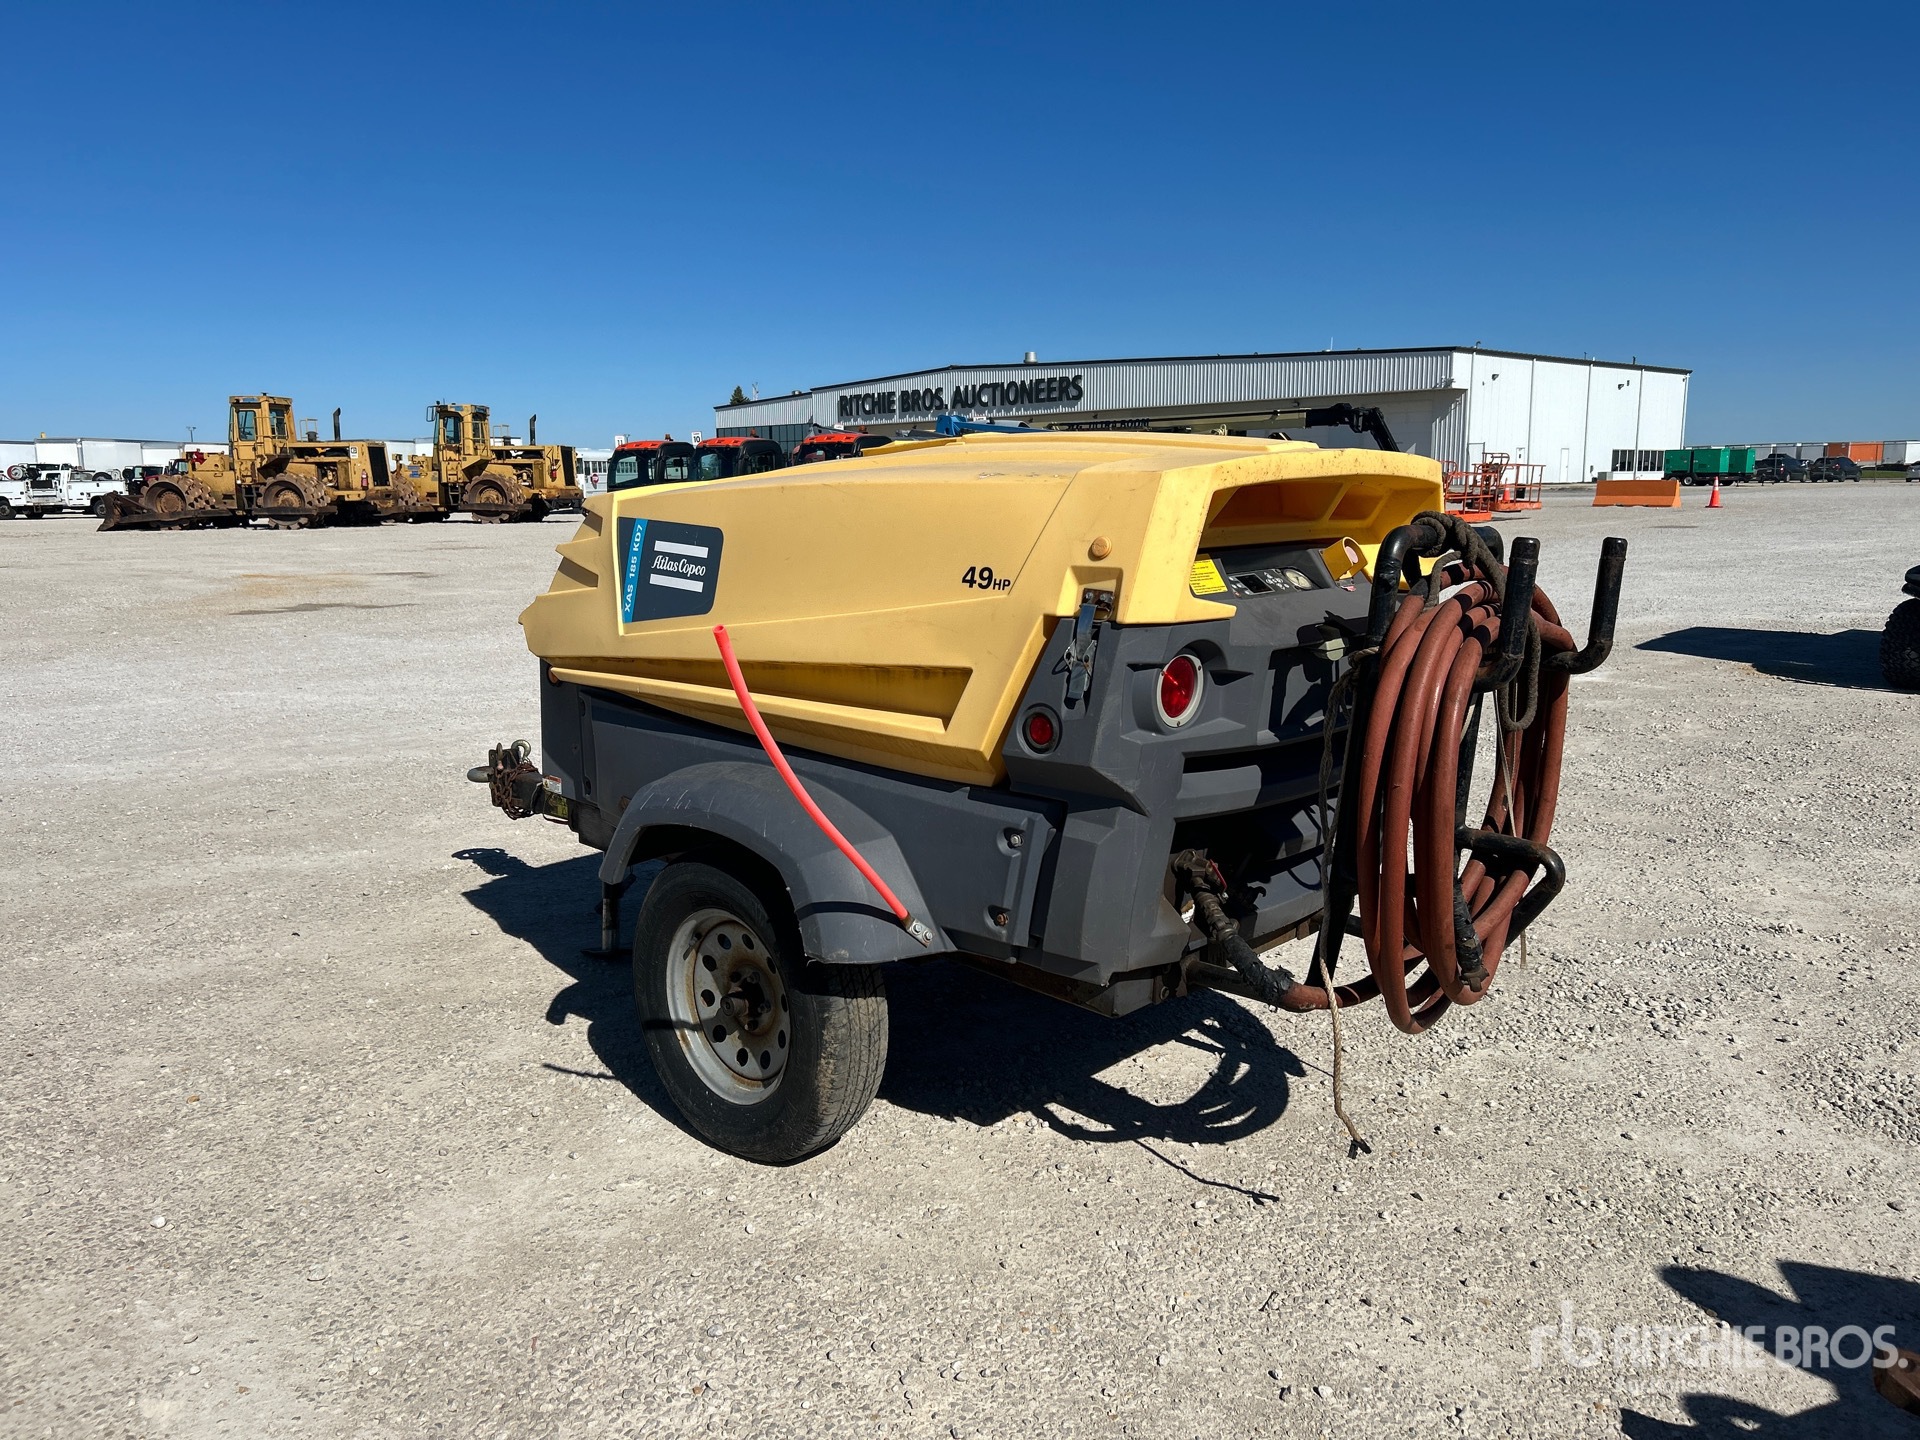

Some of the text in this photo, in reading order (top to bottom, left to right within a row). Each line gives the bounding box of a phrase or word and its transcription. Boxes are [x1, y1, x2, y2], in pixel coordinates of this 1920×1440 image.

[839, 375, 1083, 417] RITCHIE BROS. AUCTIONEERS
[693, 435, 701, 443] 10
[624, 524, 643, 613] XAS 185 KD7
[651, 555, 706, 577] Atlas Copco
